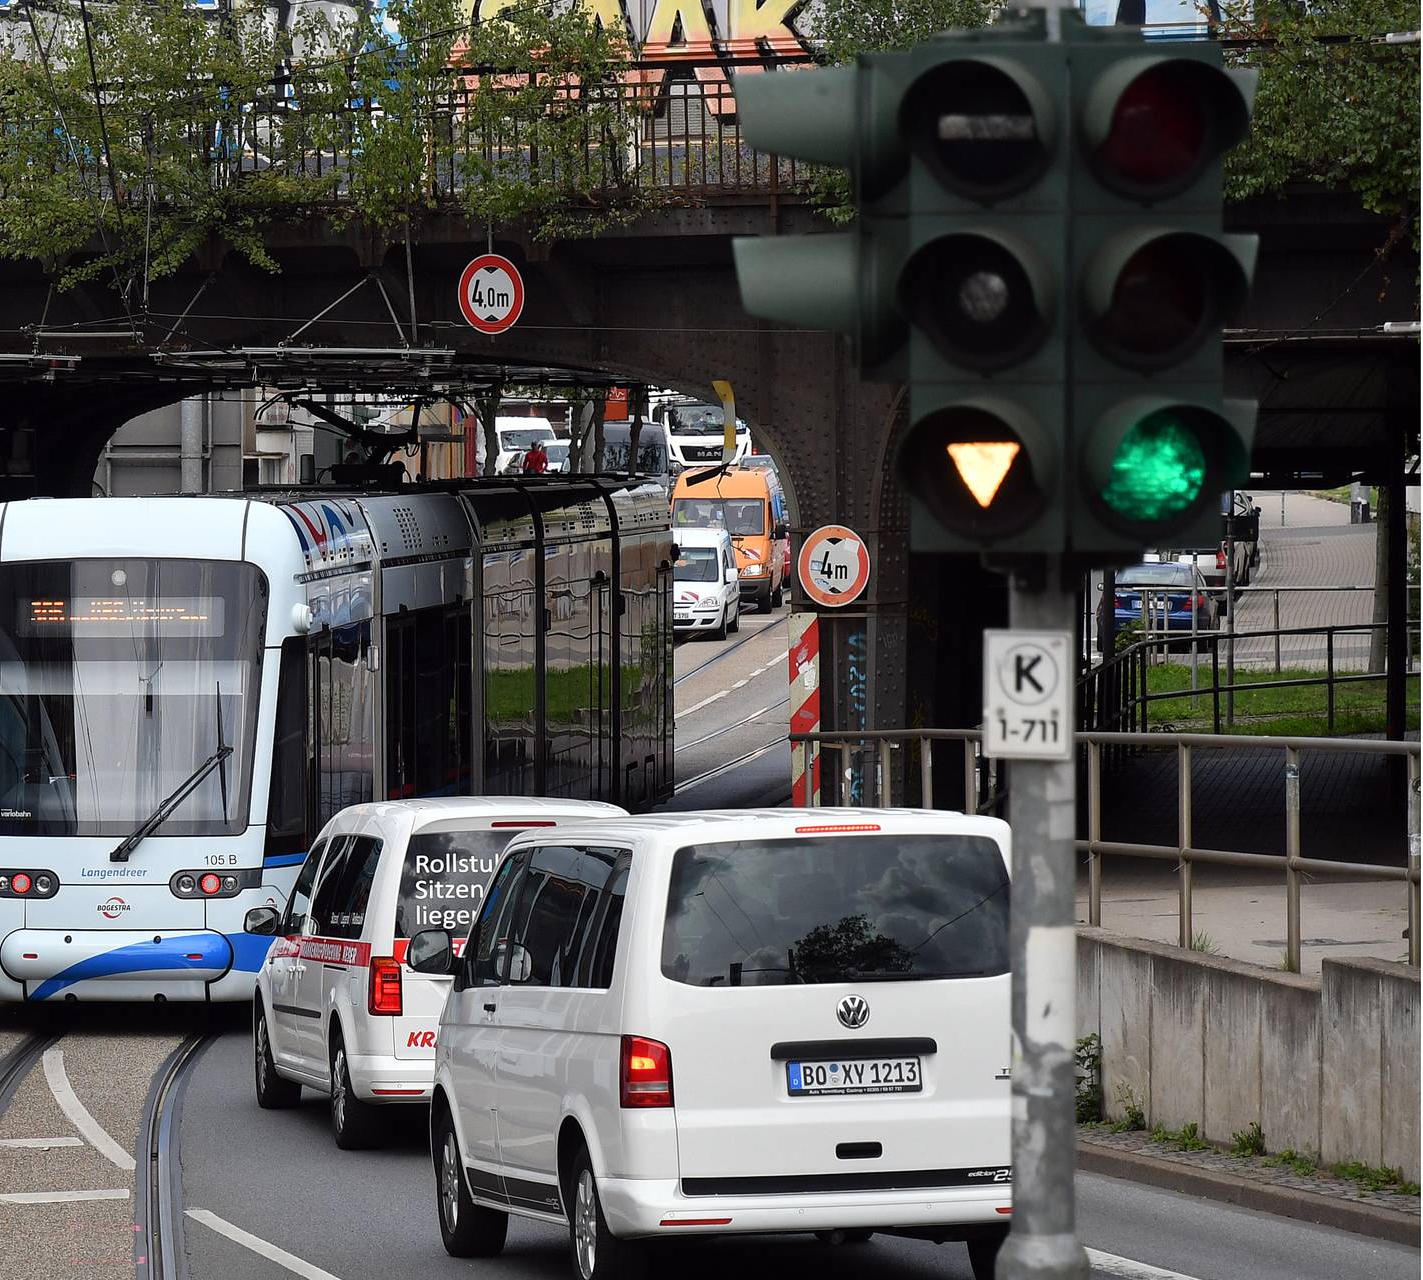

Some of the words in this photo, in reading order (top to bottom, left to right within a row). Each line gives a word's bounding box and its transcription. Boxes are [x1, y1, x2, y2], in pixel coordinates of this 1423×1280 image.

[472, 279, 509, 309] 4,0m
[820, 551, 848, 580] 4m
[1015, 655, 1044, 693] K
[999, 718, 1059, 743] 1-711
[204, 855, 225, 866] 105
[229, 855, 237, 865] B
[81, 867, 148, 880] Langendreer
[415, 880, 484, 899] Sitzen
[97, 904, 131, 912] BOGESTRA
[842, 1063, 865, 1085] XY
[870, 1061, 917, 1083] 1213
[968, 1170, 996, 1178] edition
